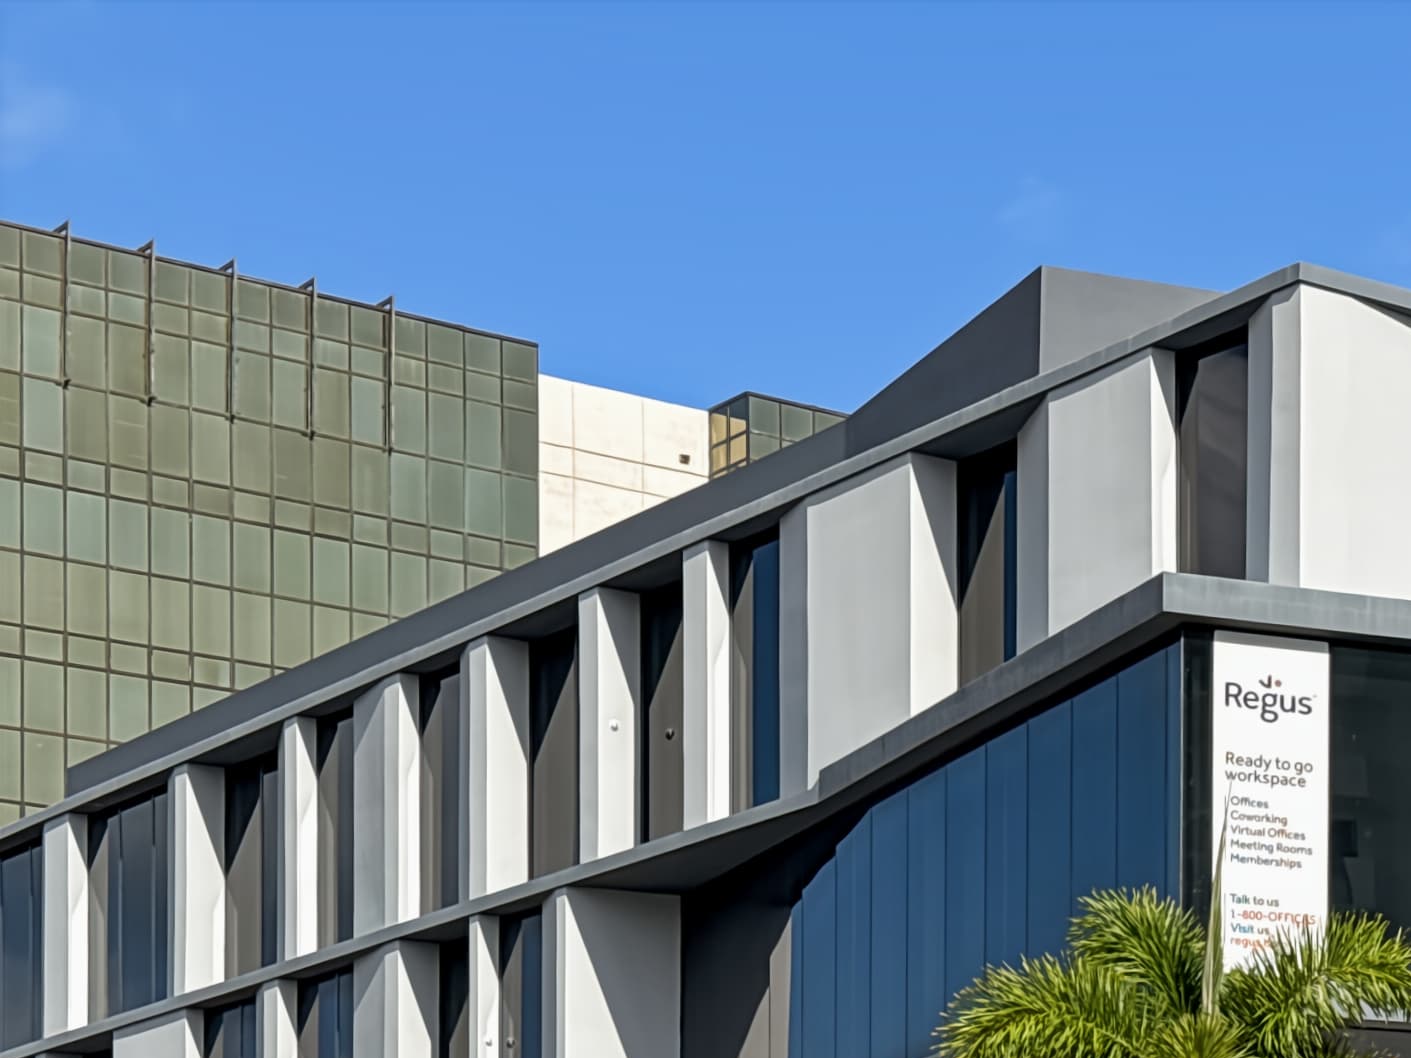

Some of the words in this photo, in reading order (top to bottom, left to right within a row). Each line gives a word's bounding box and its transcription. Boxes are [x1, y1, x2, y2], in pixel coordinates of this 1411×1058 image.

[1225, 681, 1313, 723] Regus
[1225, 751, 1272, 772] Ready
[1275, 757, 1291, 771] to
[1294, 761, 1314, 776] go
[1225, 770, 1307, 789] workspace
[1230, 795, 1269, 809] Offices
[1230, 809, 1288, 827] Coworking
[1230, 824, 1265, 837] Virtual
[1267, 827, 1306, 841] Offices
[1230, 838, 1274, 854] Meeting
[1276, 842, 1313, 855] Rooms
[1230, 853, 1303, 870] Memberships
[1230, 893, 1251, 905] Talk
[1253, 896, 1265, 906] to
[1266, 899, 1280, 908] us
[1231, 923, 1254, 934] Visit
